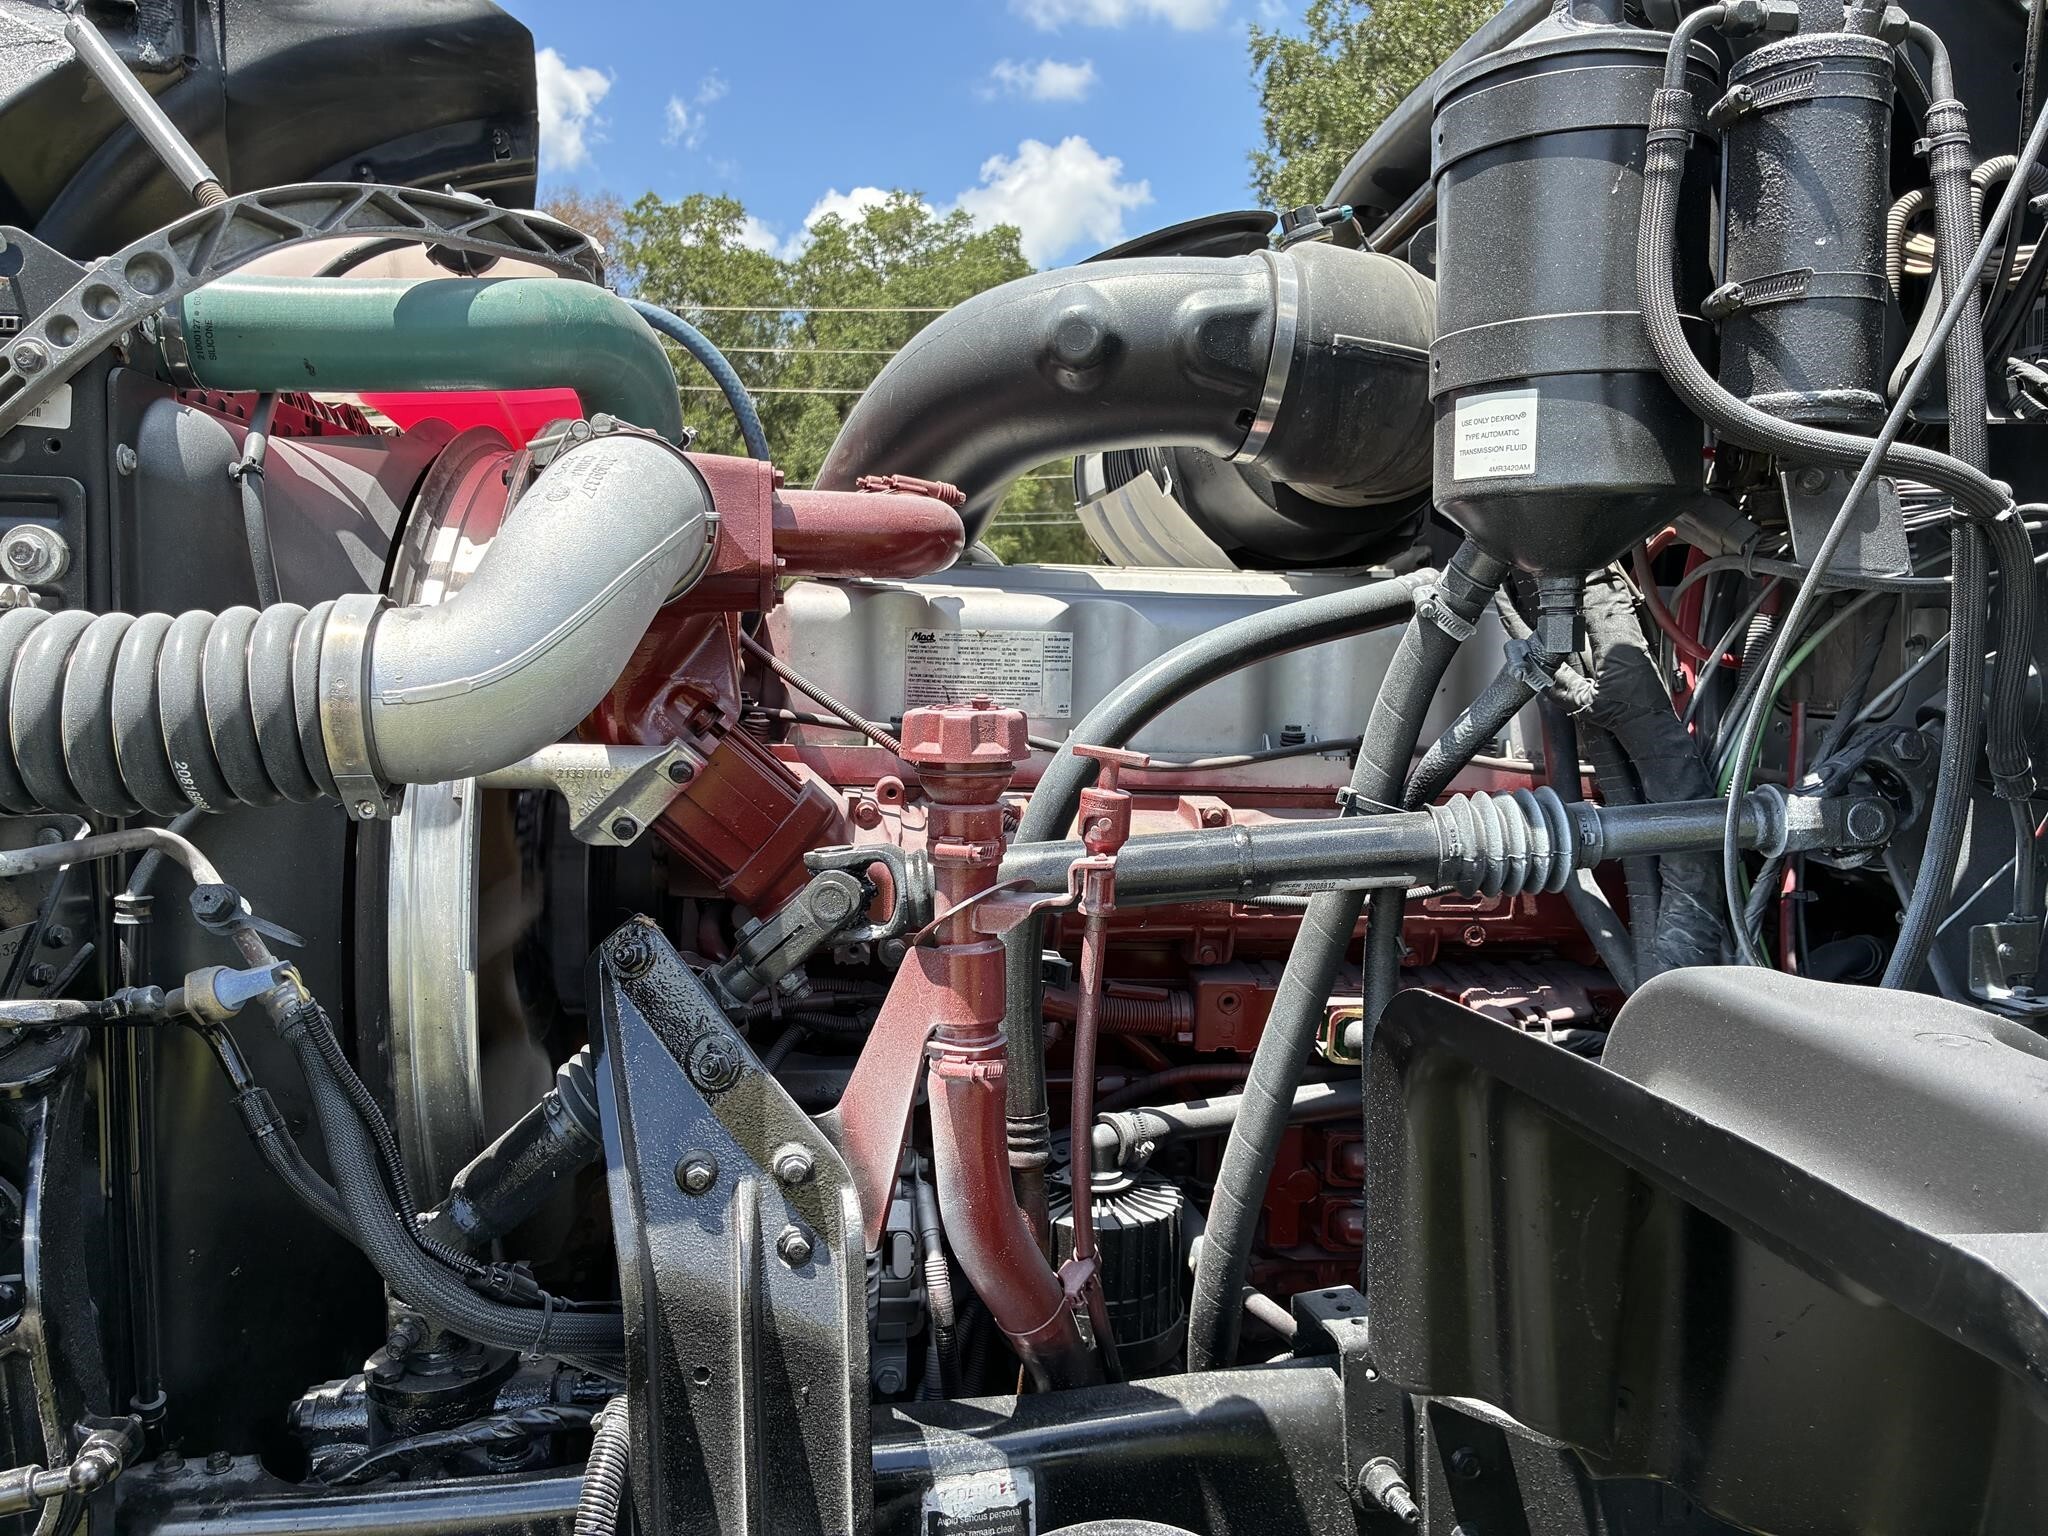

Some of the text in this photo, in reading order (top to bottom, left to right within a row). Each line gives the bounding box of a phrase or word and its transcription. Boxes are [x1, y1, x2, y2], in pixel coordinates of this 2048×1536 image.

[205, 319, 217, 360] SILICONE
[1461, 419, 1472, 427] USE
[1473, 417, 1489, 425] ONLY
[1481, 429, 1519, 439] AUTOMATIC
[1459, 444, 1527, 456] TRANSMISSION FLUID
[911, 631, 937, 643] Mack
[578, 786, 611, 817] CHINA
[989, 1507, 1022, 1520] personal
[996, 1525, 1016, 1534] clear
